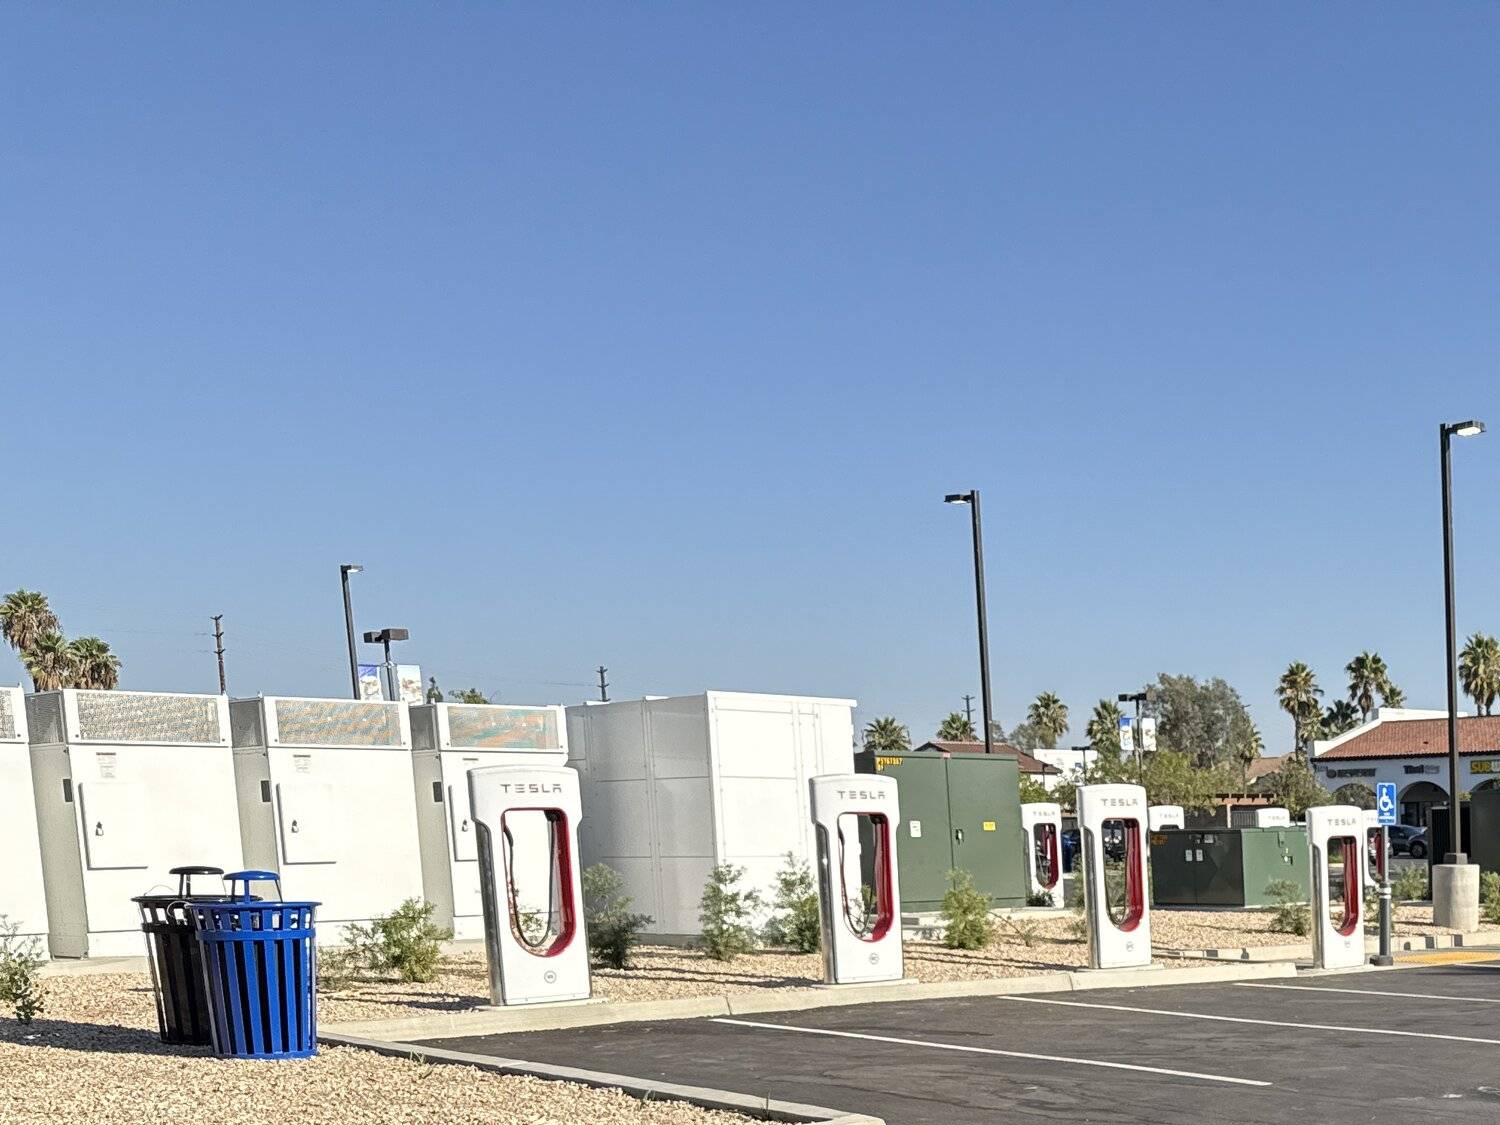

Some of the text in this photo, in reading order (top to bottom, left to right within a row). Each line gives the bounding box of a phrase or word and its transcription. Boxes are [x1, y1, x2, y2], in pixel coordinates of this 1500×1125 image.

[500, 783, 562, 794] TESLA
[838, 790, 886, 800] TESLA
[1101, 798, 1139, 807] TESLA
[1327, 818, 1357, 827] TESLA
